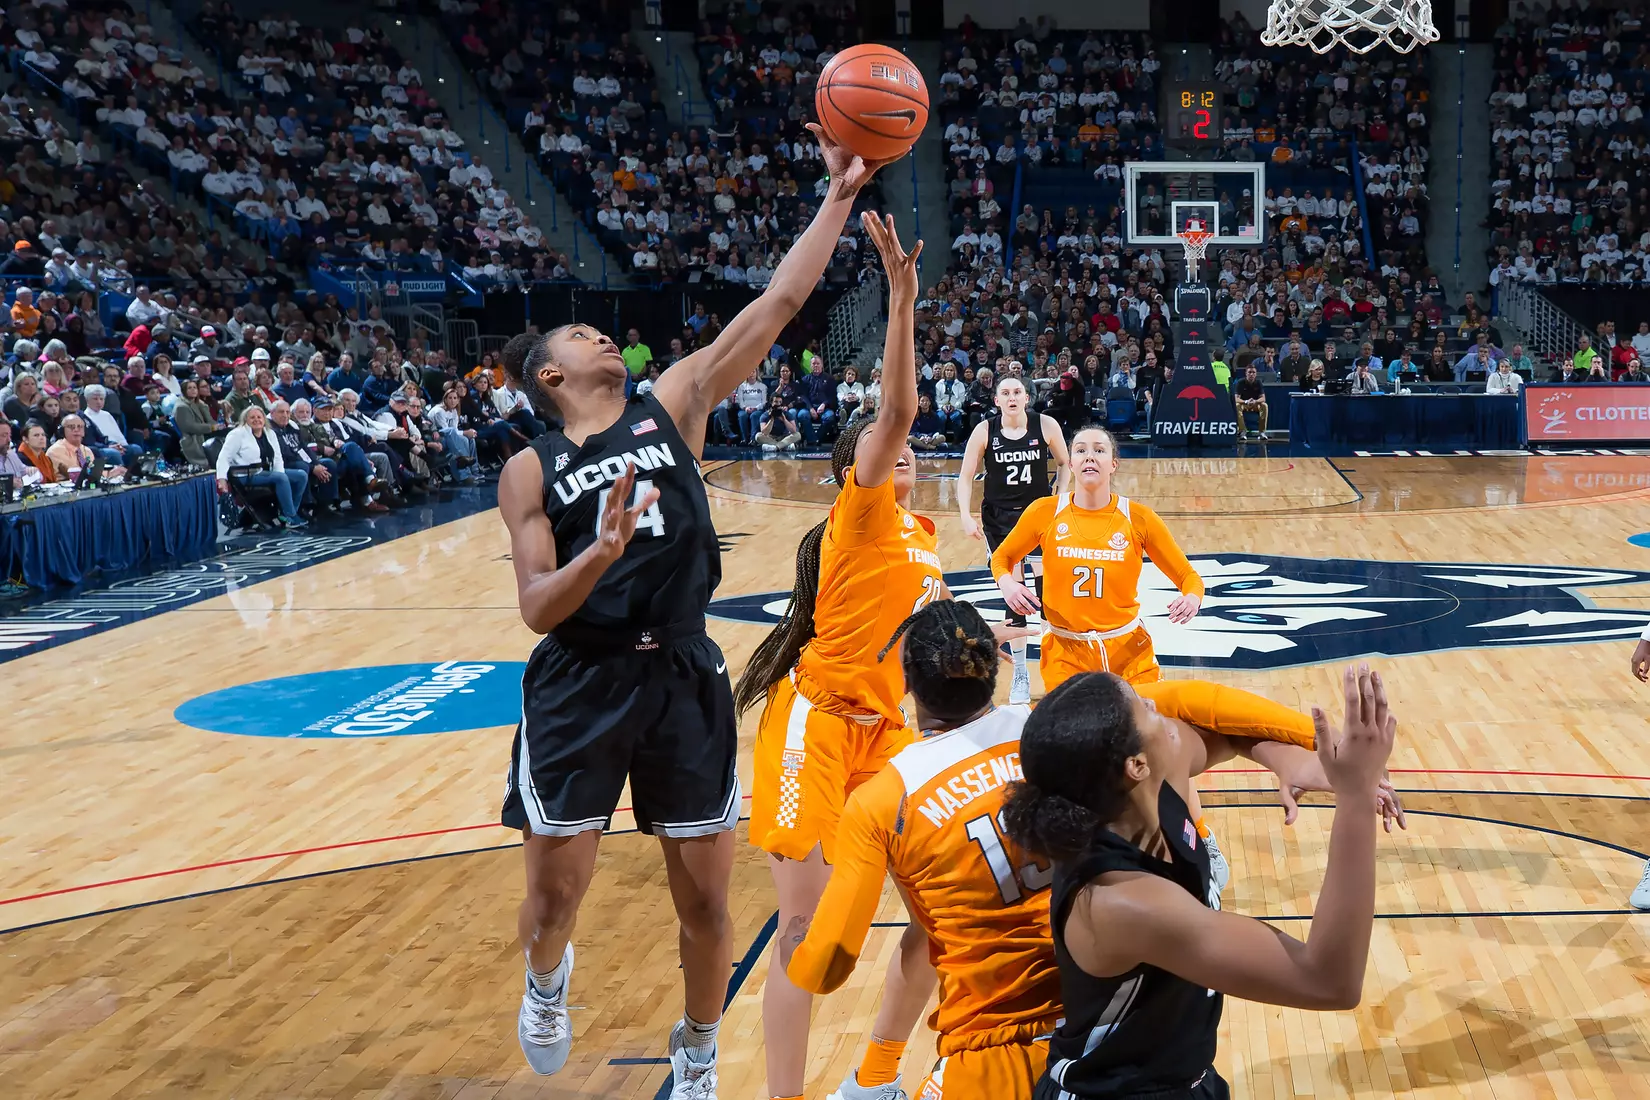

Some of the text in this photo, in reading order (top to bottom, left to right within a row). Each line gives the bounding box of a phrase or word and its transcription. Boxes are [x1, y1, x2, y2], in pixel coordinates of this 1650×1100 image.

[1181, 91, 1215, 108] 8:12
[1193, 109, 1211, 139] 2
[403, 281, 420, 291] BUD
[421, 281, 445, 291] LIGHT
[1180, 287, 1206, 295] SPALDING
[1575, 406, 1650, 420] CTLOTTE
[1154, 421, 1237, 435] TRAVELERS
[994, 449, 1040, 463] UCONN
[553, 442, 677, 506] UCONN
[1006, 464, 1032, 485] 24
[596, 479, 666, 538] 4
[1056, 546, 1126, 562] TENNESSEE
[1073, 566, 1104, 599] 21
[635, 643, 659, 651] UCONN
[917, 752, 1025, 829] MASSENG
